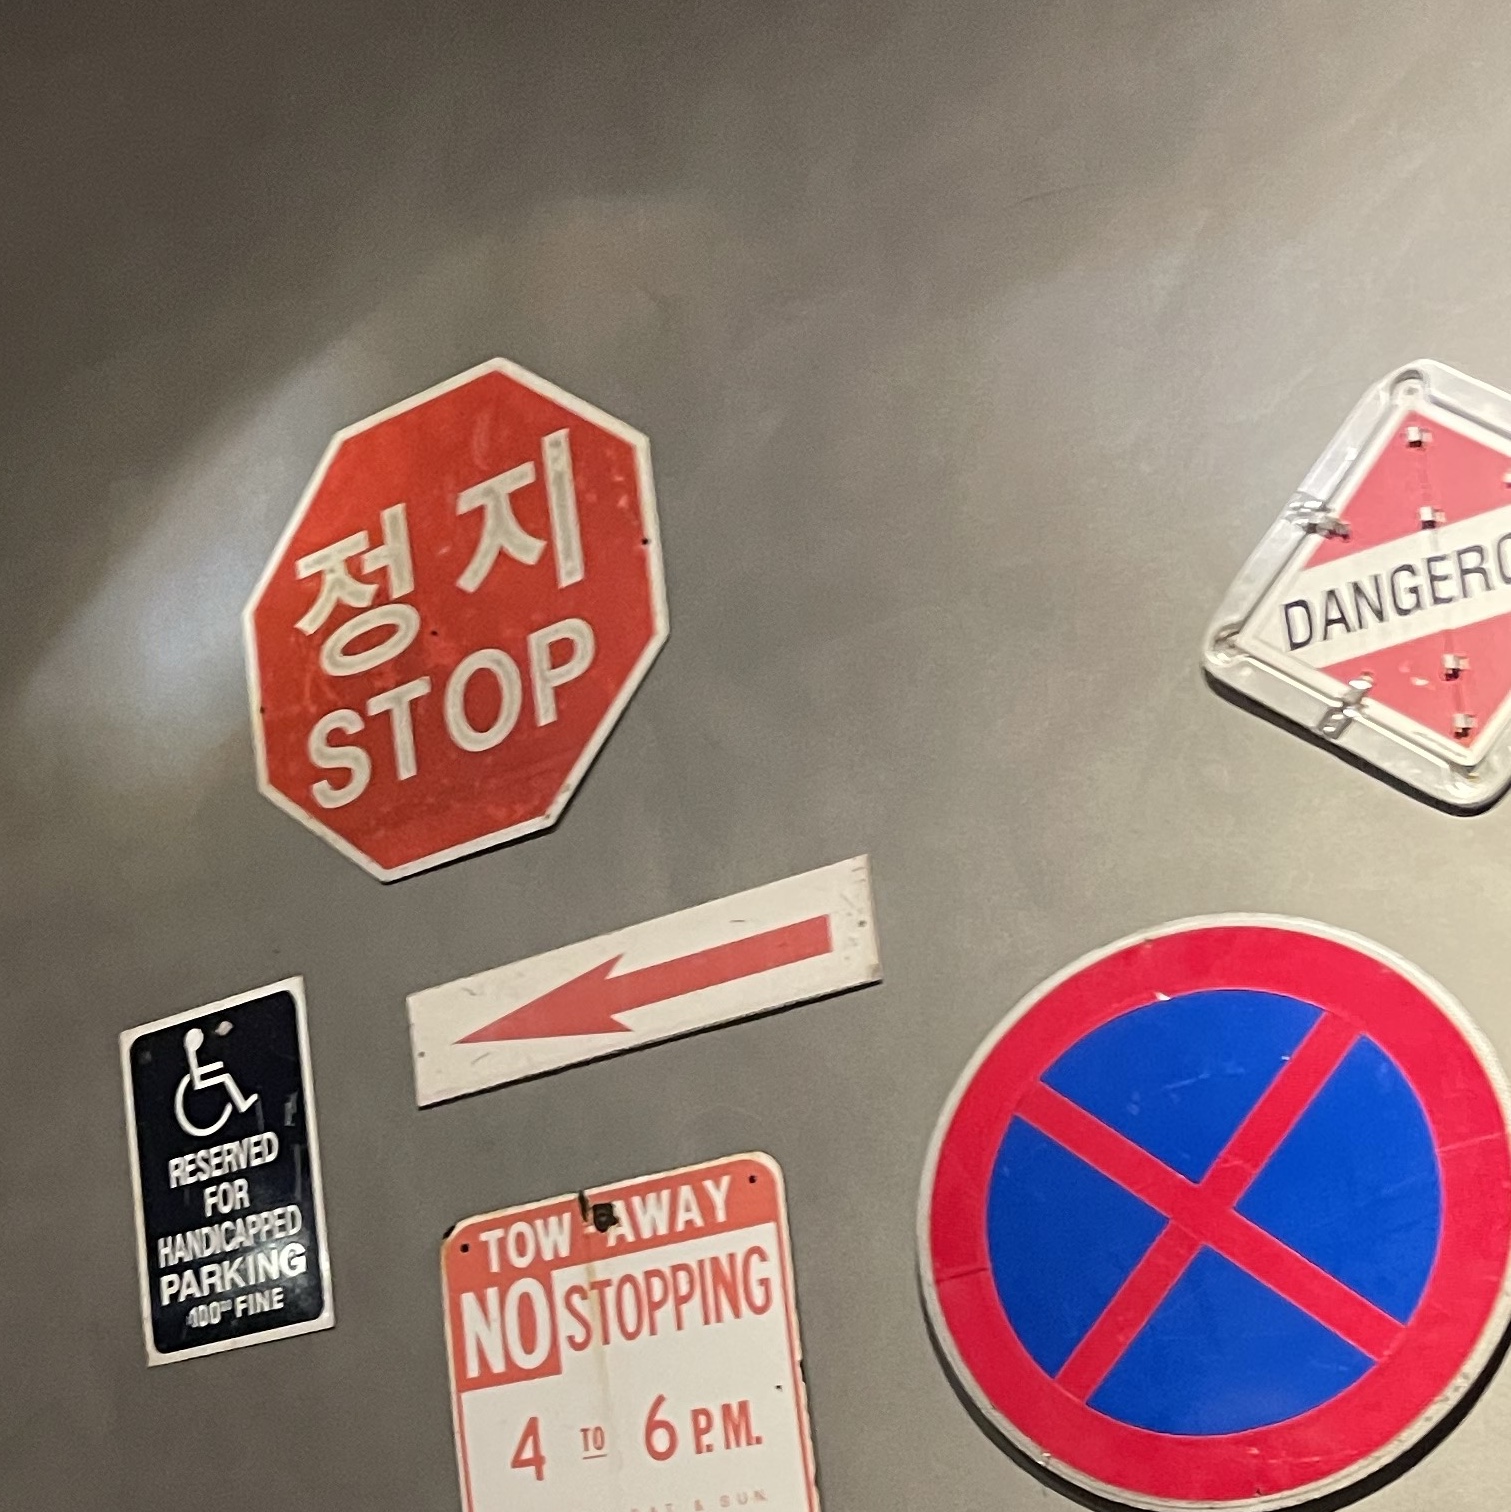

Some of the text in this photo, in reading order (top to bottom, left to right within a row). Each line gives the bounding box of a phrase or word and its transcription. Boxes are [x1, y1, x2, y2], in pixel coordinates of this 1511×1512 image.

[307, 618, 596, 809] STOP
[168, 1131, 279, 1188] RESERVED
[203, 1178, 251, 1218] FOR
[157, 1204, 303, 1268] HANDICAPPED
[160, 1242, 308, 1306] PARKING
[234, 1287, 285, 1318] FINE
[460, 1245, 773, 1379] NO STOPPING
[510, 1394, 763, 1481] 4 TO 6 P.M.
